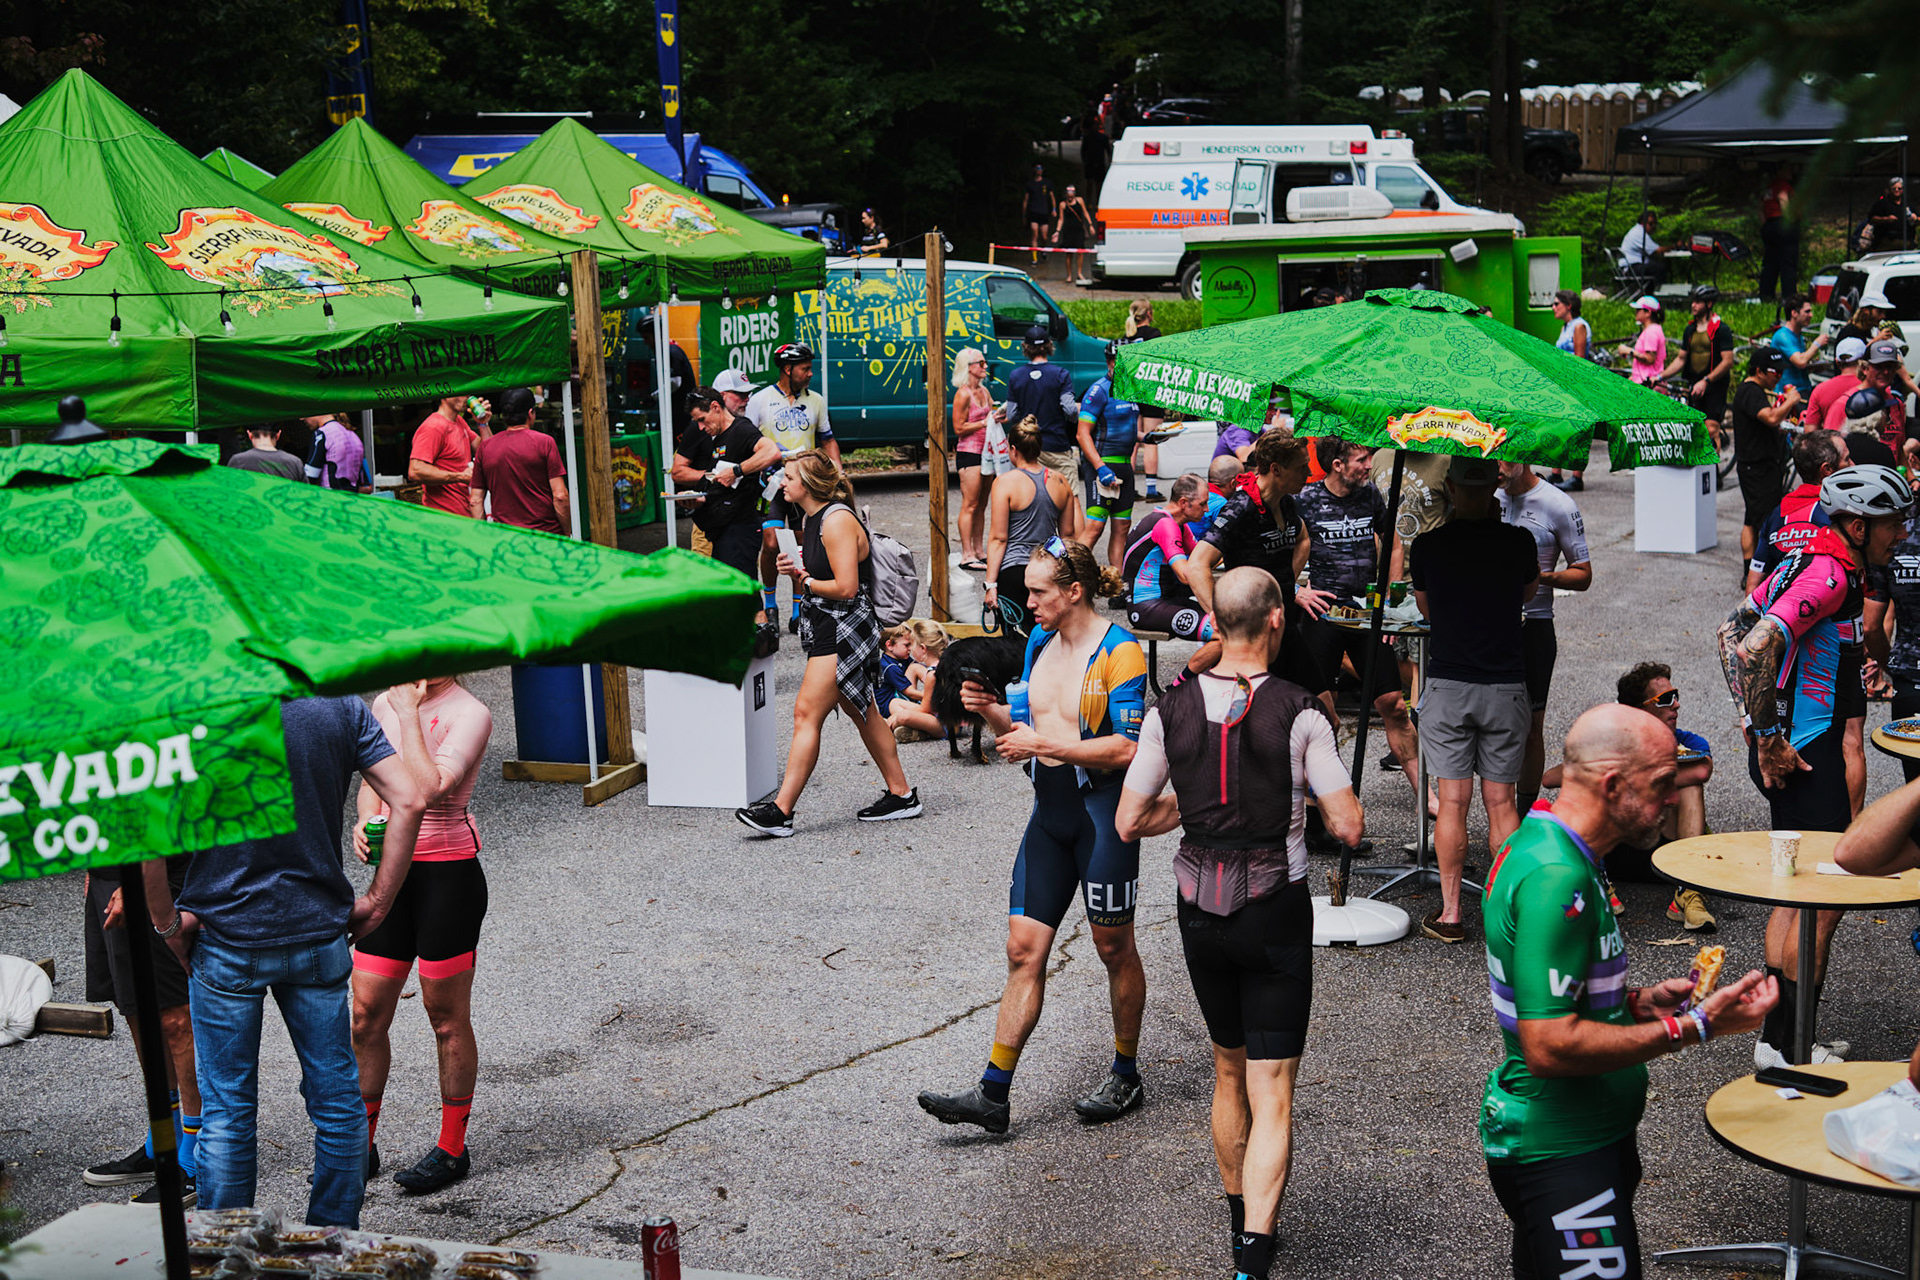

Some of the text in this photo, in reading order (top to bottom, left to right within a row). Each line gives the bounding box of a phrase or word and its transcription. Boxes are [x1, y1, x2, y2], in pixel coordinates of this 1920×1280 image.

[1202, 145, 1306, 154] HENDERSON COUNTY
[1127, 181, 1175, 191] RESCUE
[517, 195, 572, 222] NEVADA
[1151, 212, 1227, 225] AMBULANC
[0, 228, 61, 261] VADA
[188, 226, 322, 265] SIERRA NEVADA
[713, 256, 792, 280] SIERRA NEVADA
[793, 288, 838, 317] AZY
[720, 310, 780, 346] RIDERS
[315, 333, 499, 381] SIERRA NEVADA
[728, 342, 773, 374] ONLY
[374, 381, 455, 401] BREWING CO.
[1134, 361, 1253, 403] SIERRA NEVADA
[1154, 386, 1209, 411] BREWING
[1405, 420, 1487, 441] SIERRA NEVADA
[1319, 528, 1374, 538] VETERANS
[1782, 539, 1809, 548] Racin
[33, 814, 109, 860] CO.
